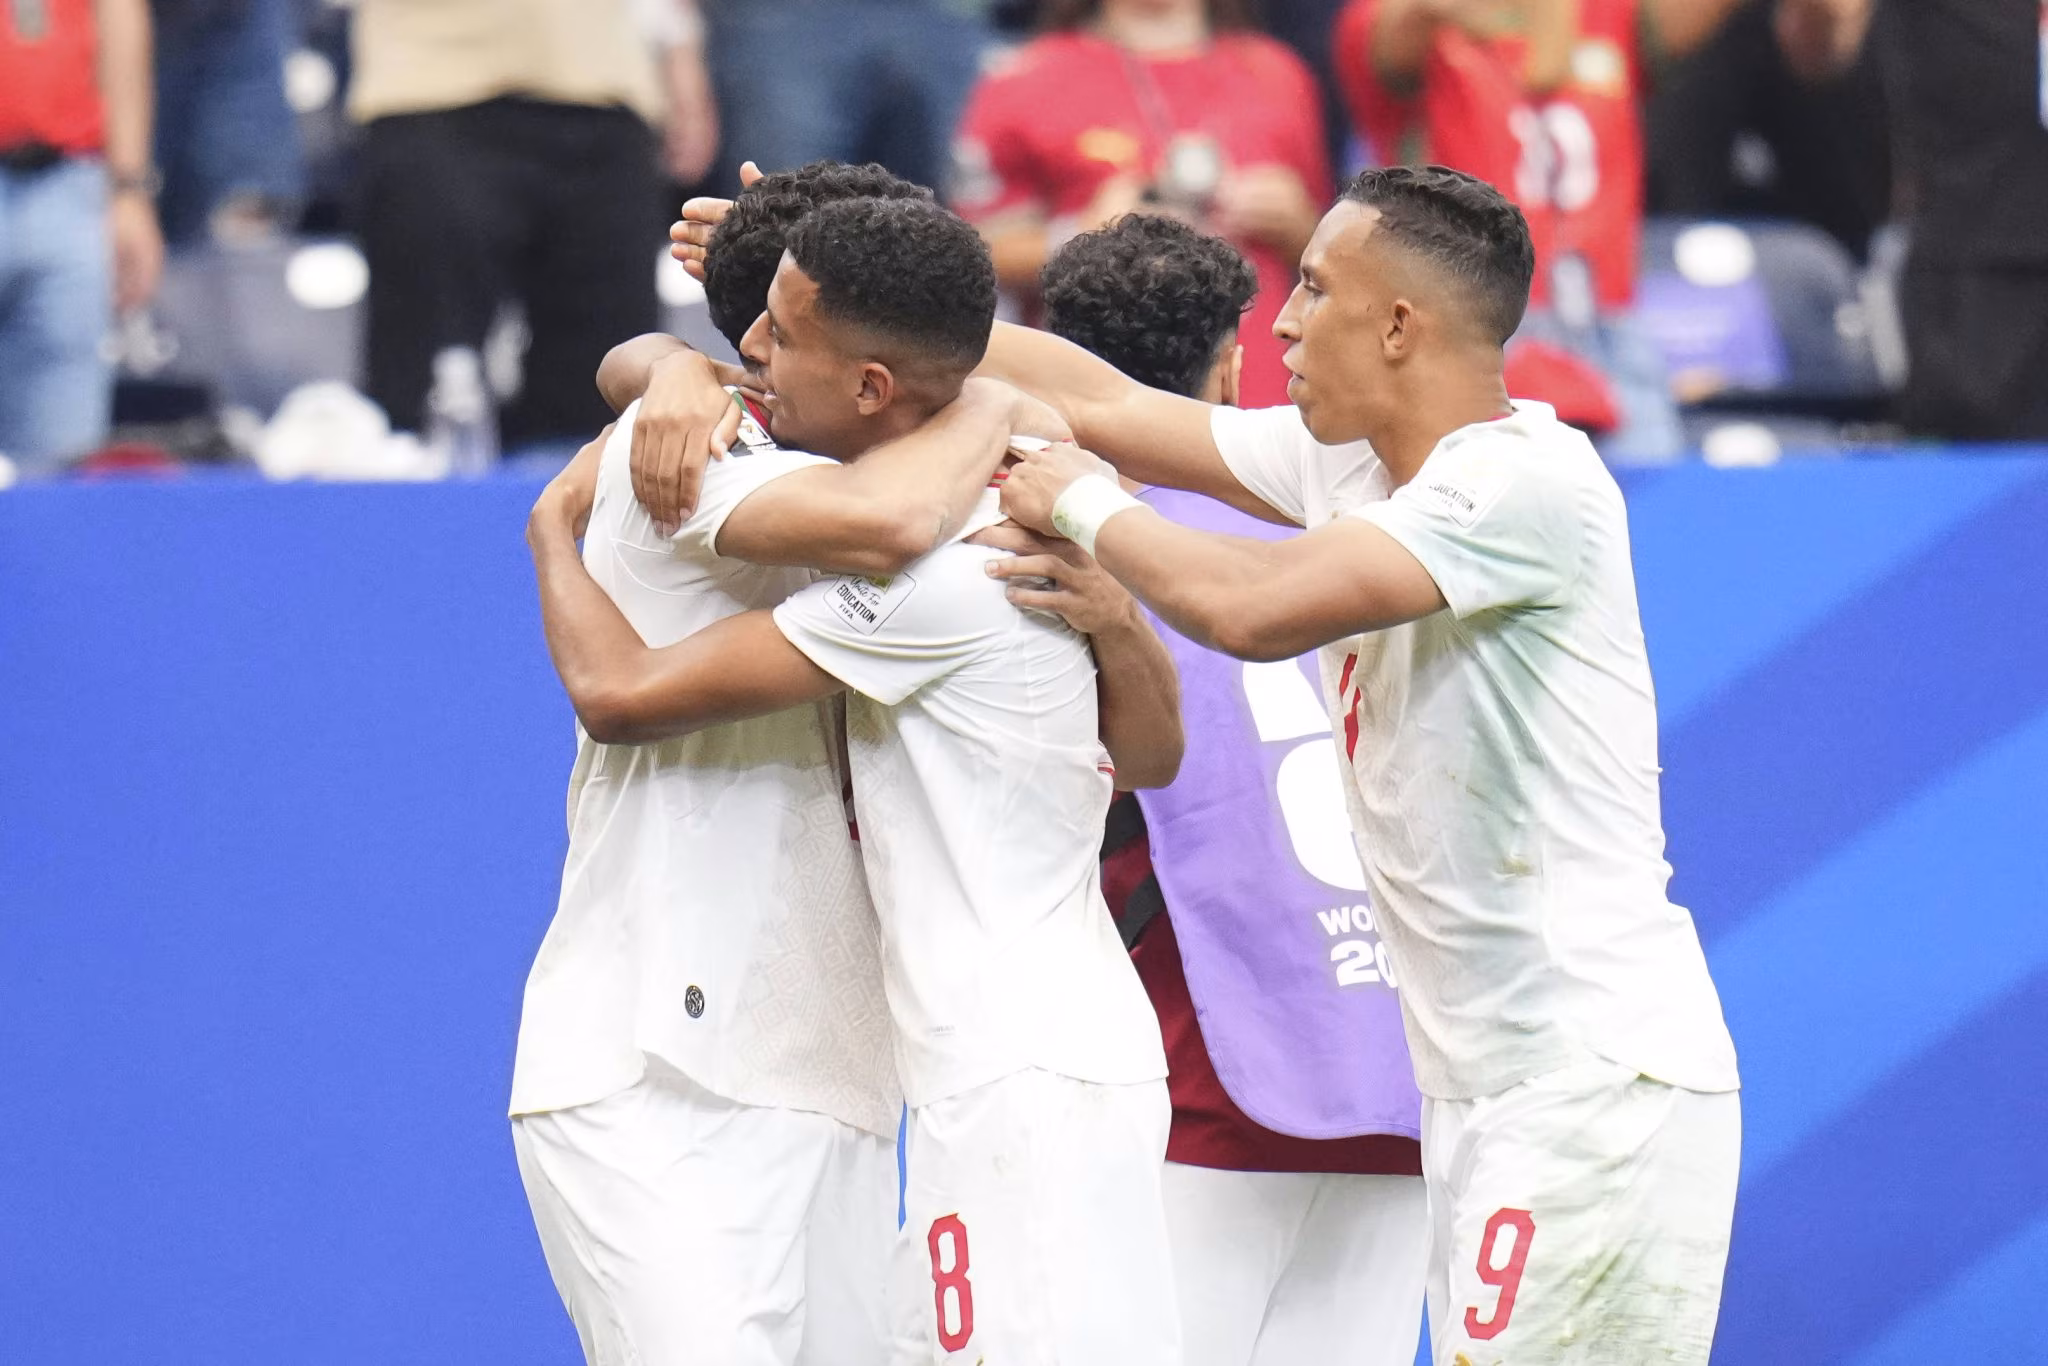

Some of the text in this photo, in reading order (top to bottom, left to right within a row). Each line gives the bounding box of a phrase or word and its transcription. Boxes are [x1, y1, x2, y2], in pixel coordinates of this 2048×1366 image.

[837, 584, 878, 624] EDUCATION
[839, 604, 854, 620] FIFA
[1316, 904, 1379, 936] WO
[928, 1213, 973, 1353] 8
[1464, 1207, 1536, 1341] 9
